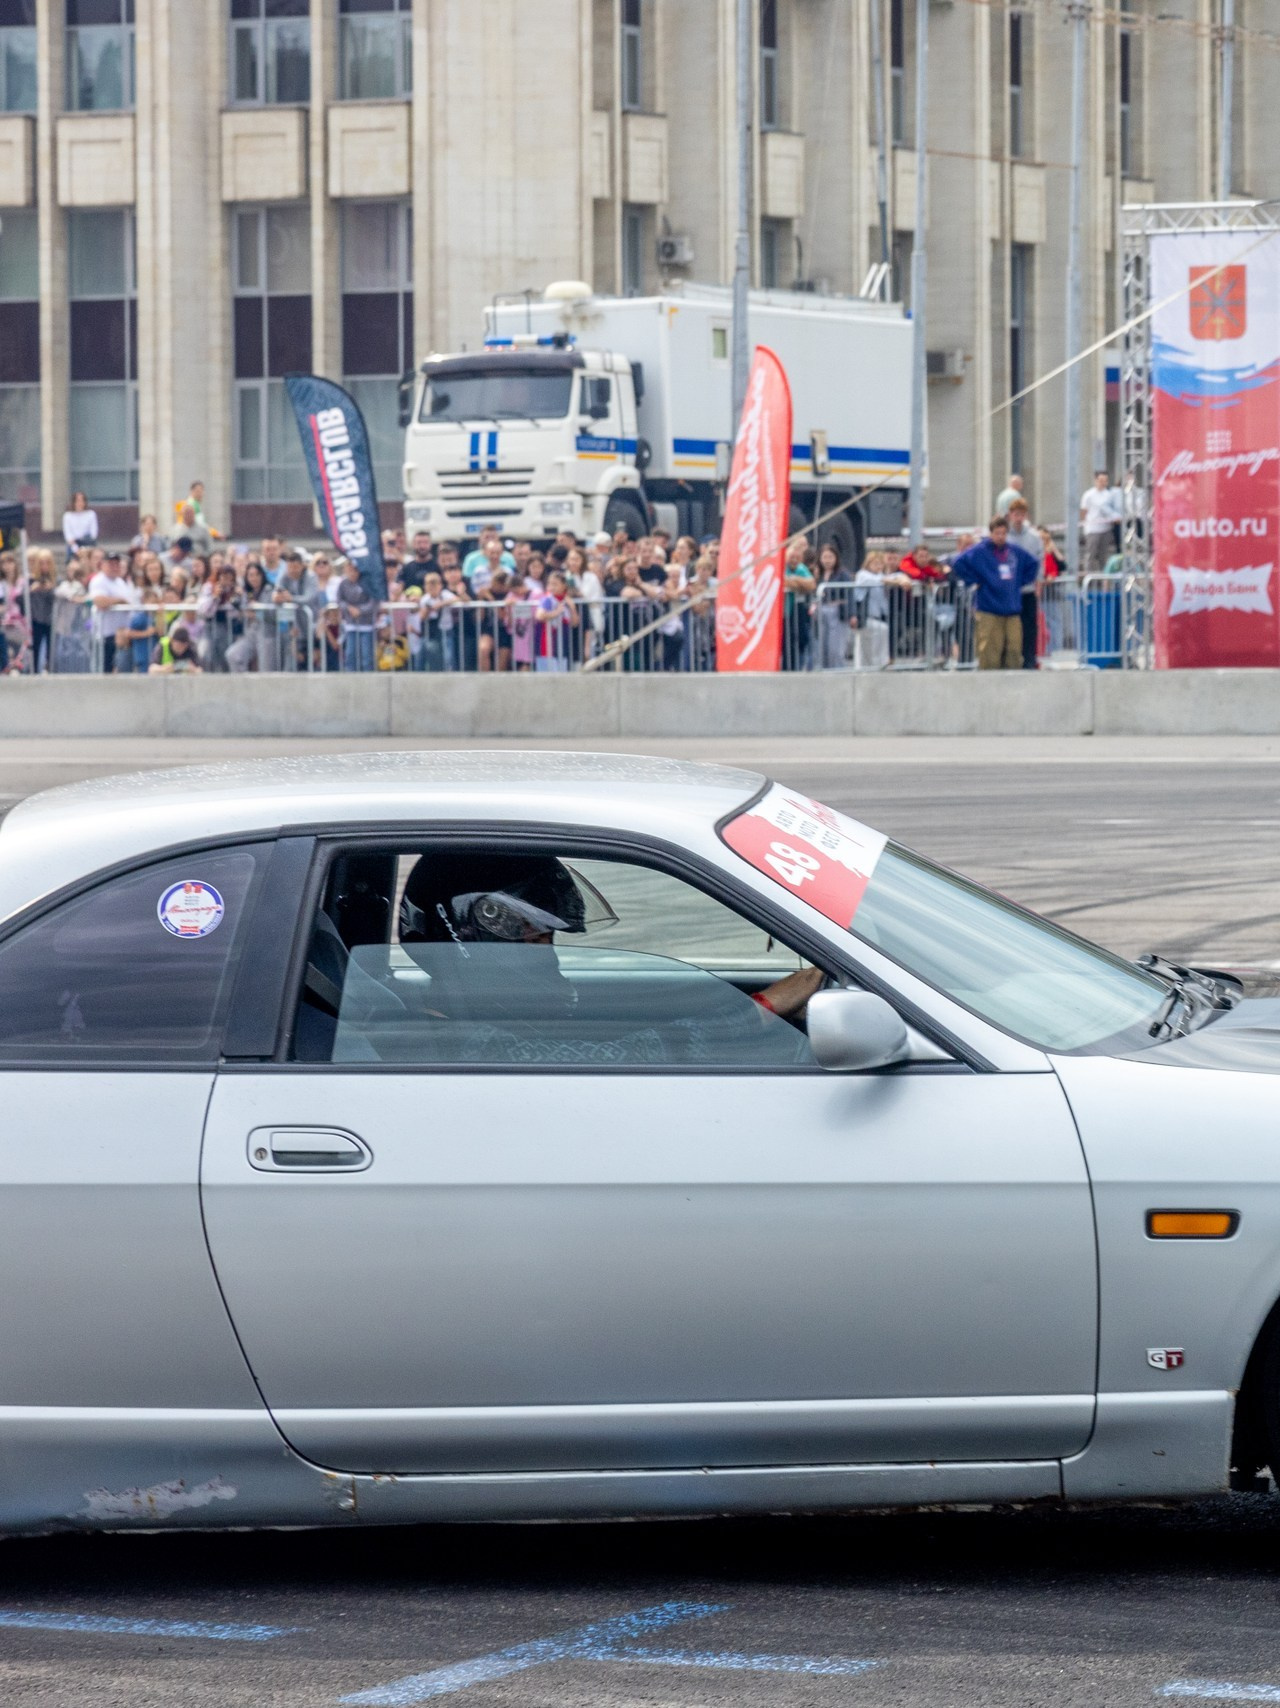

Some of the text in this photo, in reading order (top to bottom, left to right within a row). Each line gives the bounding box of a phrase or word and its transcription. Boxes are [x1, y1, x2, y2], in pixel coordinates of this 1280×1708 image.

[1173, 517, 1268, 538] auto.ru
[764, 841, 822, 887] 48
[1151, 1352, 1182, 1367] GT
